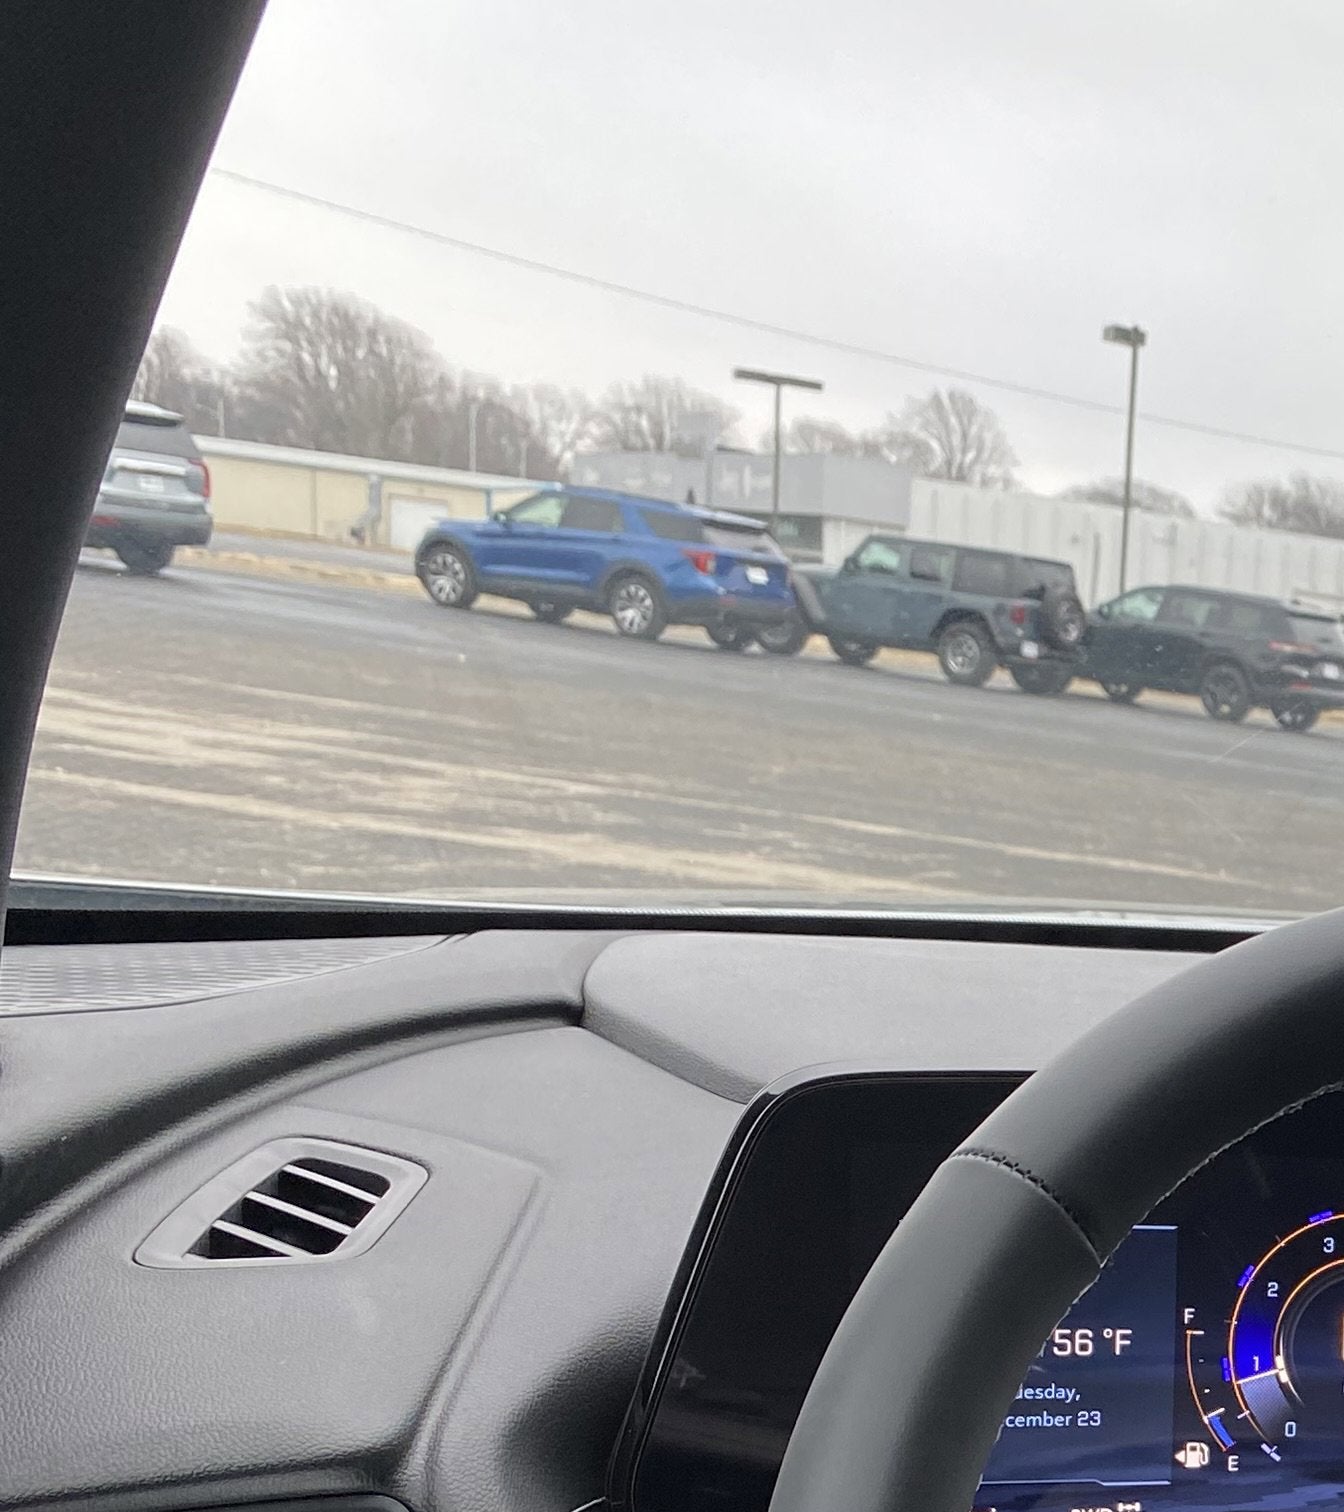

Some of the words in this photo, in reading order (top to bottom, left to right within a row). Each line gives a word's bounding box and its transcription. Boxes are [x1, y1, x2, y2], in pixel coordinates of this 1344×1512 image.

[1323, 1237, 1335, 1253] 3
[1267, 1282, 1279, 1298] 2
[1184, 1308, 1195, 1325] F
[1053, 1328, 1094, 1356] 56
[1252, 1356, 1260, 1371] 1
[1015, 1382, 1081, 1404] uesday,
[1005, 1411, 1073, 1428] cember
[1076, 1411, 1101, 1427] 23
[1284, 1422, 1297, 1438] 0
[1227, 1455, 1239, 1472] E
